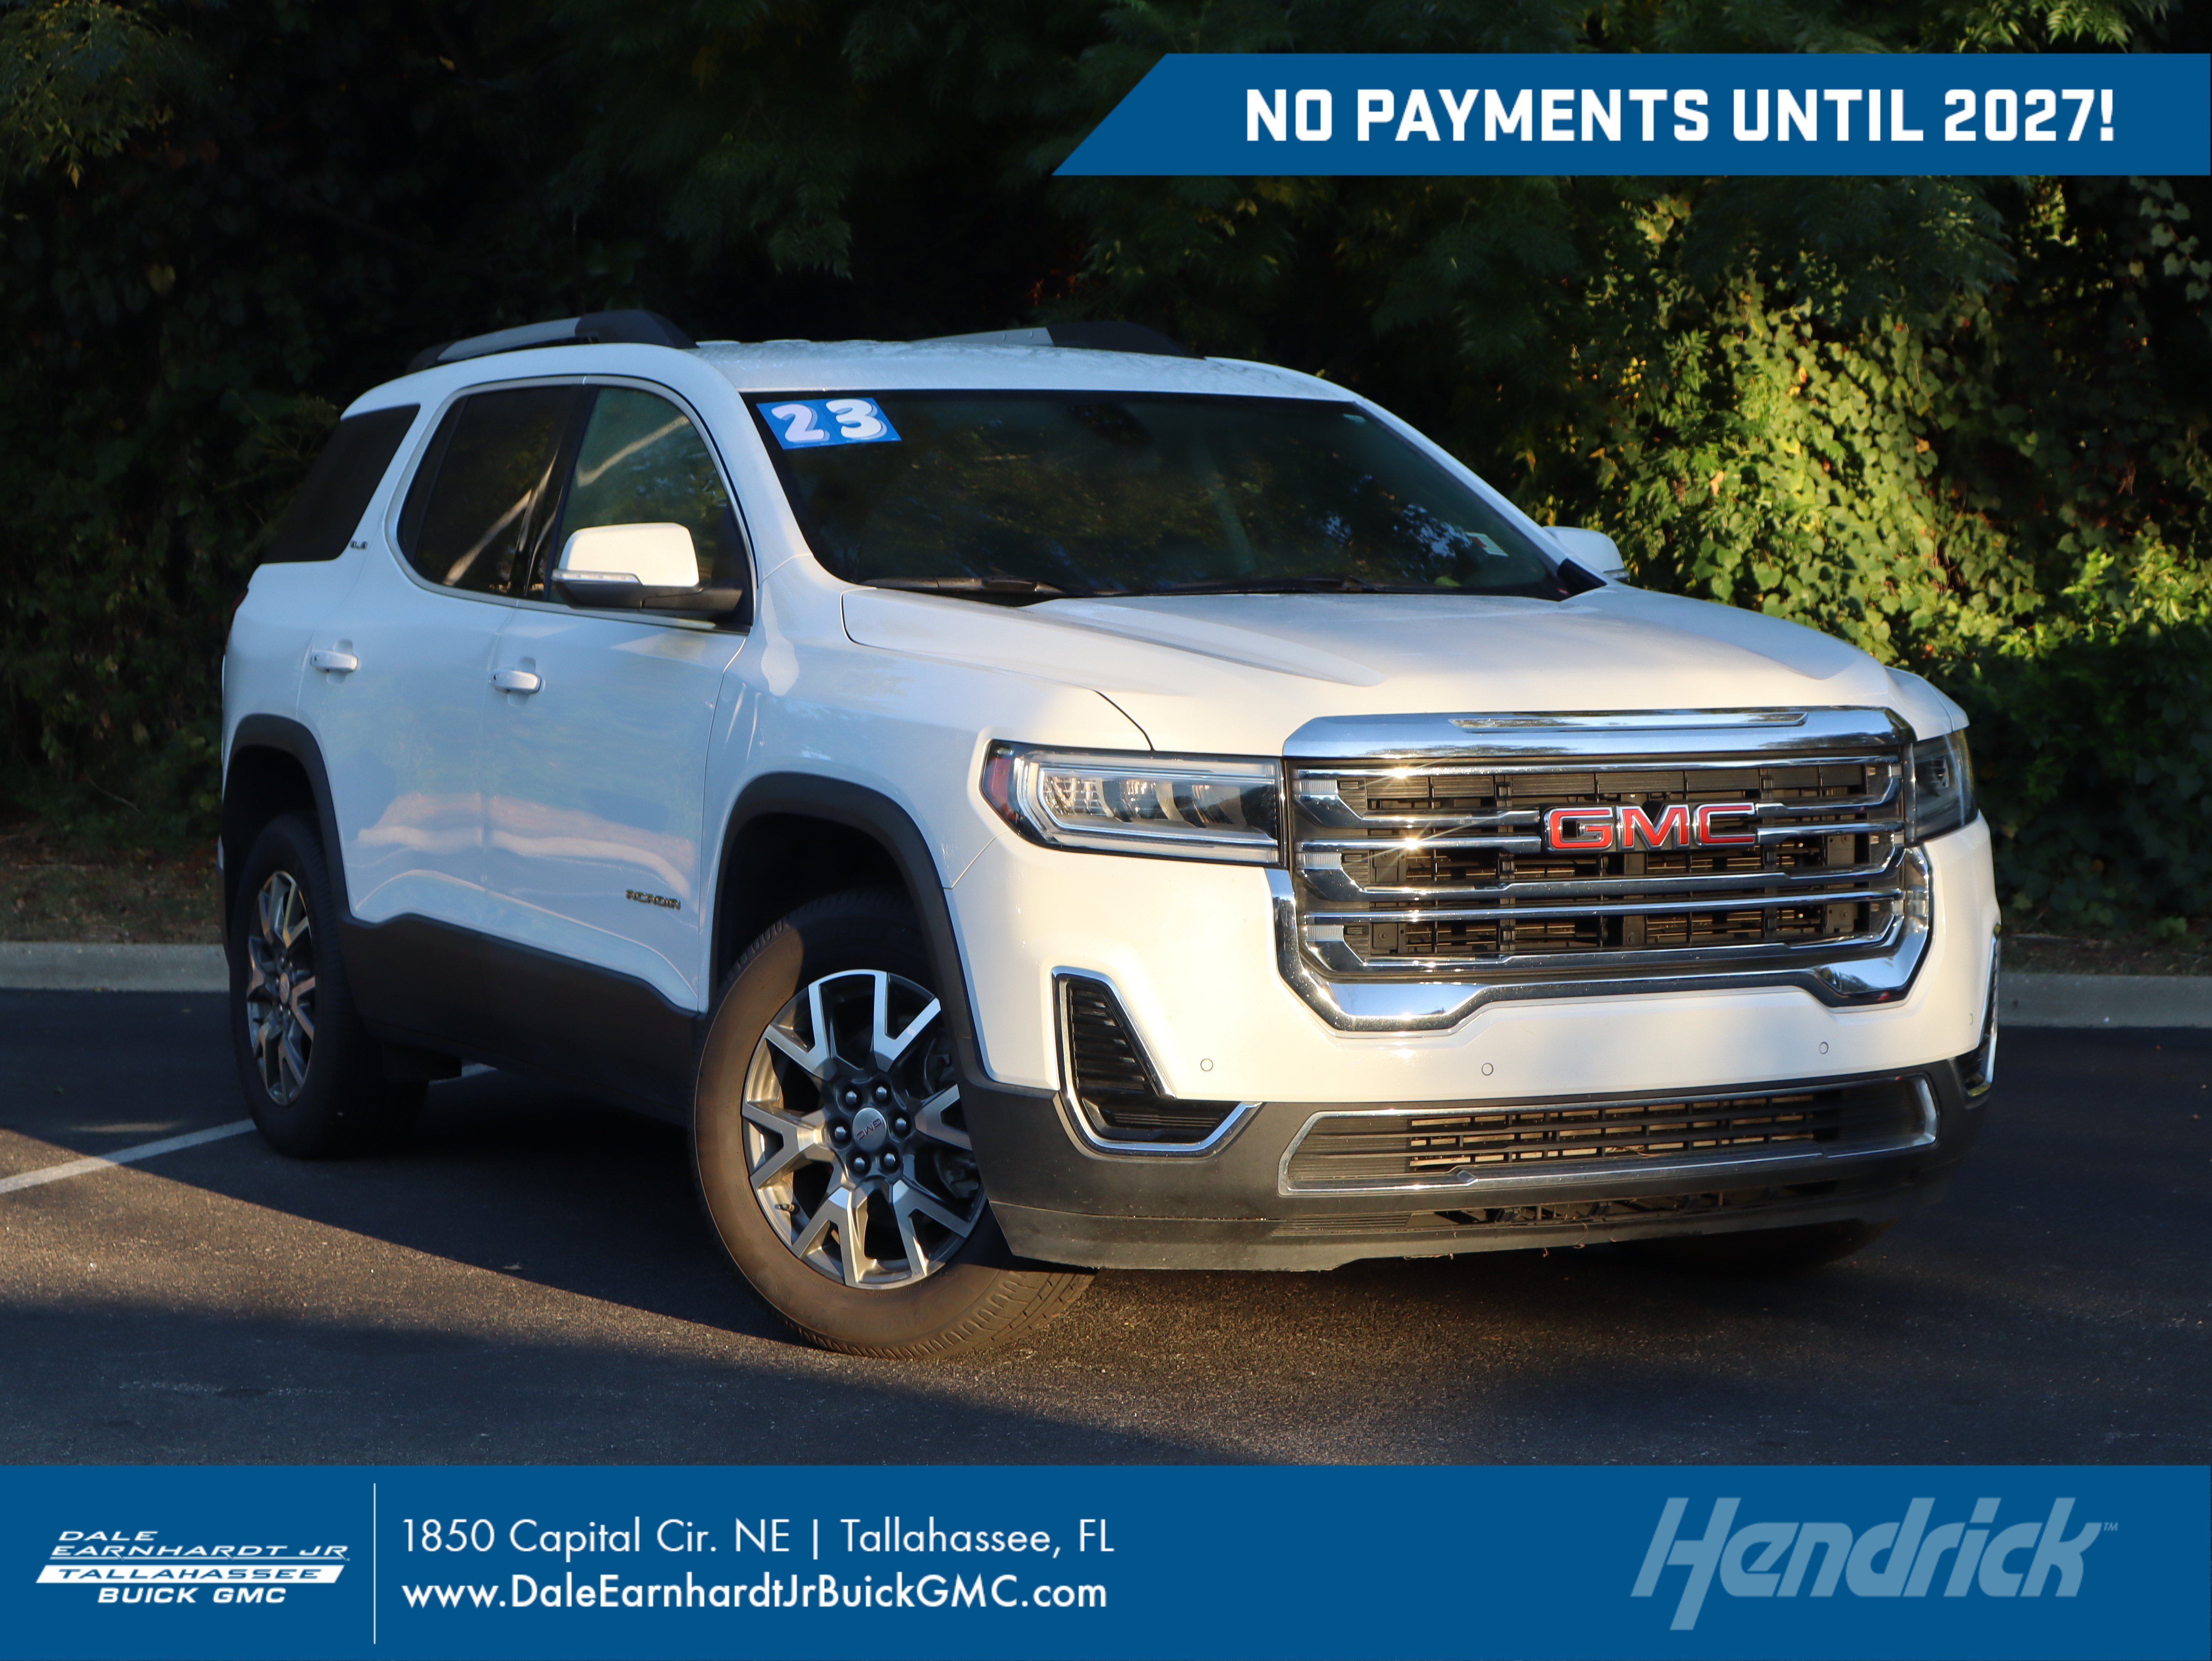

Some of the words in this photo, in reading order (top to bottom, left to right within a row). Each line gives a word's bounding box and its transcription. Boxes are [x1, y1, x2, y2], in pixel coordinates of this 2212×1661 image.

[771, 398, 886, 443] 23
[1544, 802, 1756, 853] GMC
[856, 1118, 882, 1141] GMC
